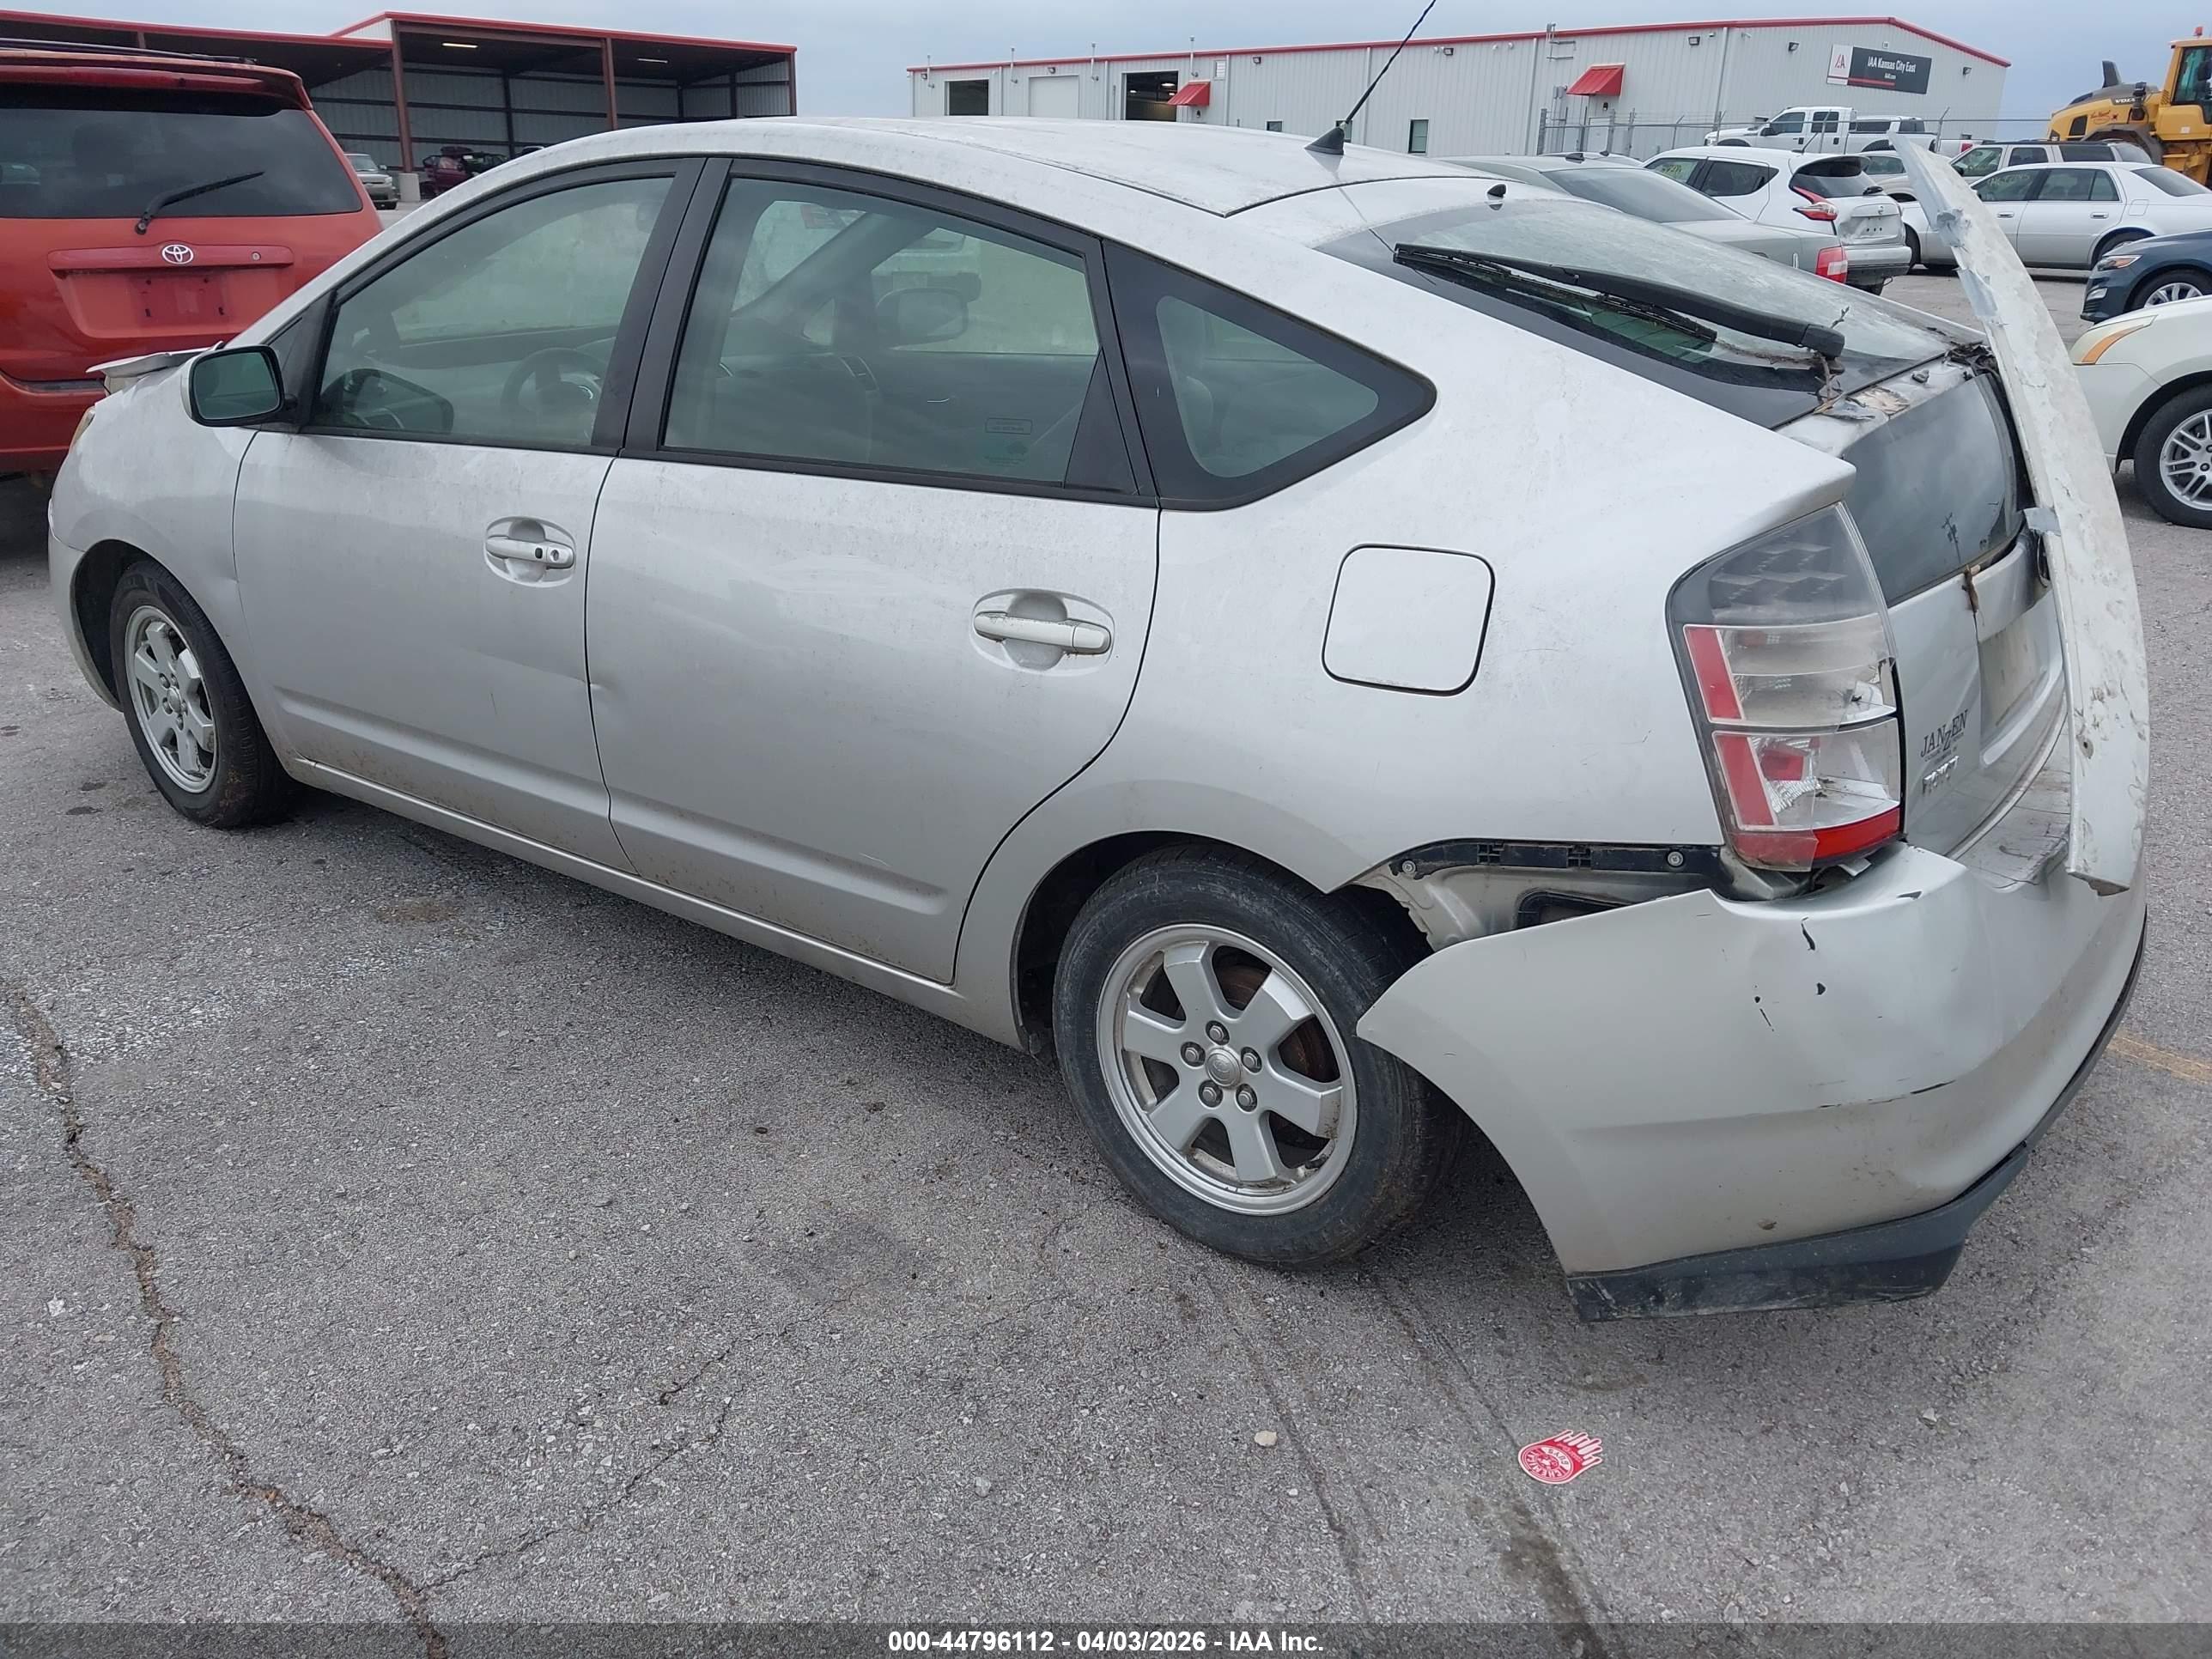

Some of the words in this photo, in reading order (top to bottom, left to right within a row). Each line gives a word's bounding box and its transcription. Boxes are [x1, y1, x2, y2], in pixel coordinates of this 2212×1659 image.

[1868, 57, 1877, 68] IAA
[1878, 58, 1895, 70] Kansas
[1896, 60, 1905, 73] City
[1905, 62, 1916, 73] East
[1920, 709, 1968, 757] JANZEN
[1548, 1449, 1569, 1465] GUYS
